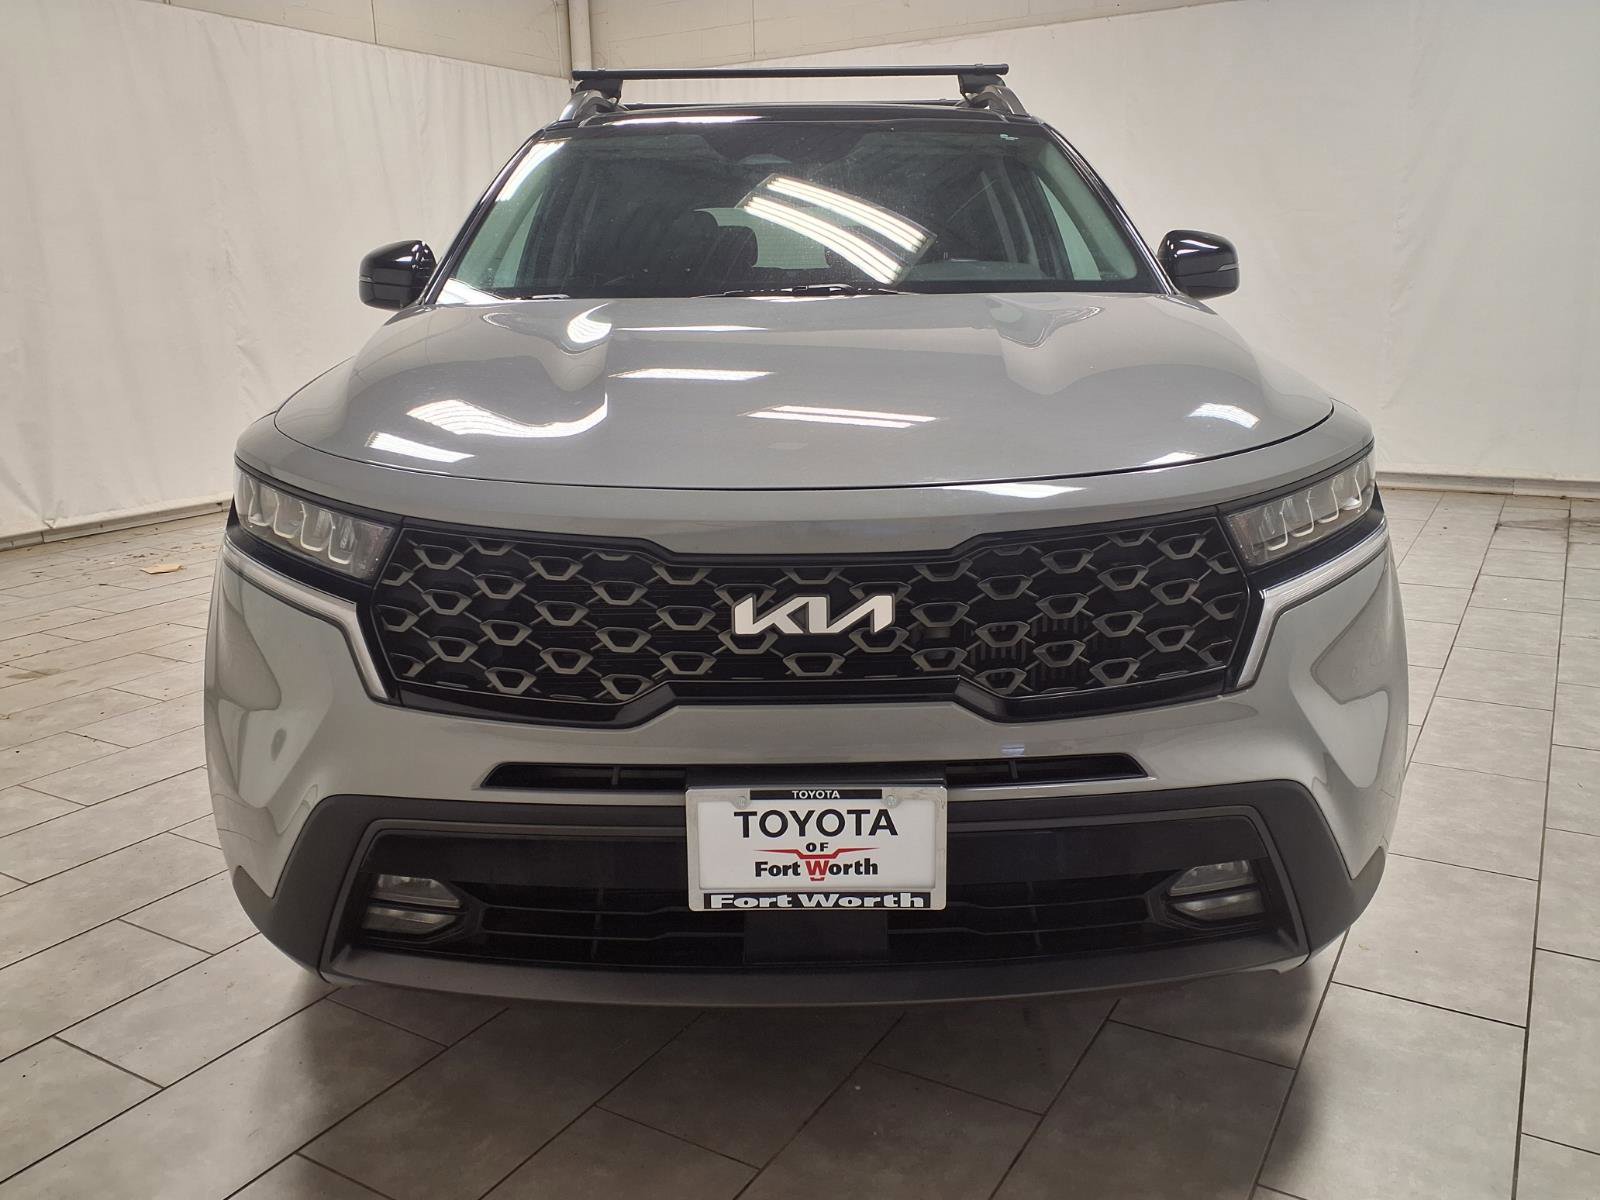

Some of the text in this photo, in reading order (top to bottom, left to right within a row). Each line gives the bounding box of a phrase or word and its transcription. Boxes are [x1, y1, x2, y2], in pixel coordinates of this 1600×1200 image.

[733, 594, 894, 635] KIA
[791, 790, 840, 799] TOYOTA
[733, 809, 898, 838] TOYOTA
[805, 842, 829, 852] OF
[755, 858, 878, 877] Fort Worth
[710, 892, 924, 909] Fort Worth
